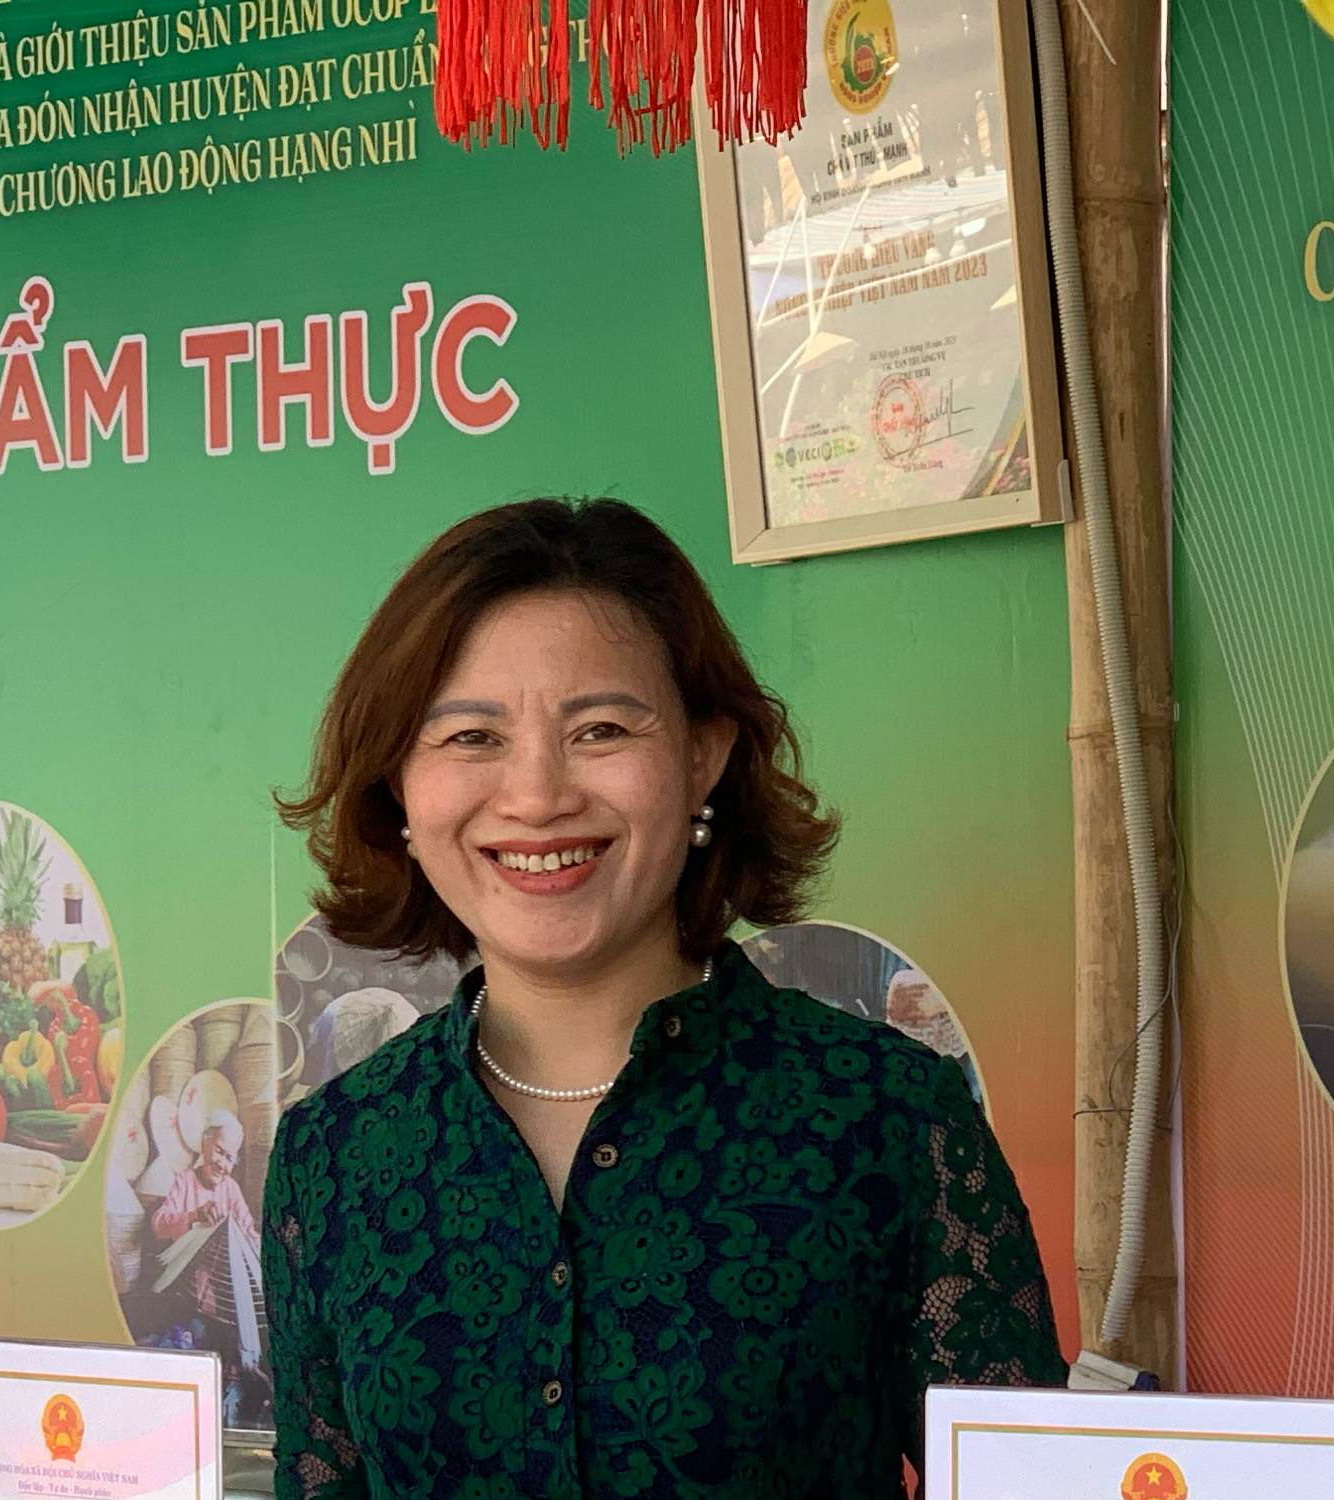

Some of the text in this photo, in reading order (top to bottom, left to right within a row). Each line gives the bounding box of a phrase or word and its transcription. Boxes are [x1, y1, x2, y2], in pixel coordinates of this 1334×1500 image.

[16, 21, 75, 79] GIỚI
[80, 9, 171, 70] THIỆU
[17, 91, 76, 146] ĐÓN
[83, 79, 163, 137] NHẬN
[169, 63, 272, 121] HUYỆN
[278, 59, 337, 112] ĐẠT
[122, 152, 174, 198] LAO
[179, 136, 263, 195] ĐỘNG
[268, 127, 353, 184] HẠNG
[359, 100, 417, 167] NHÌ
[954, 252, 988, 283] 2023
[181, 281, 520, 476] THỰC
